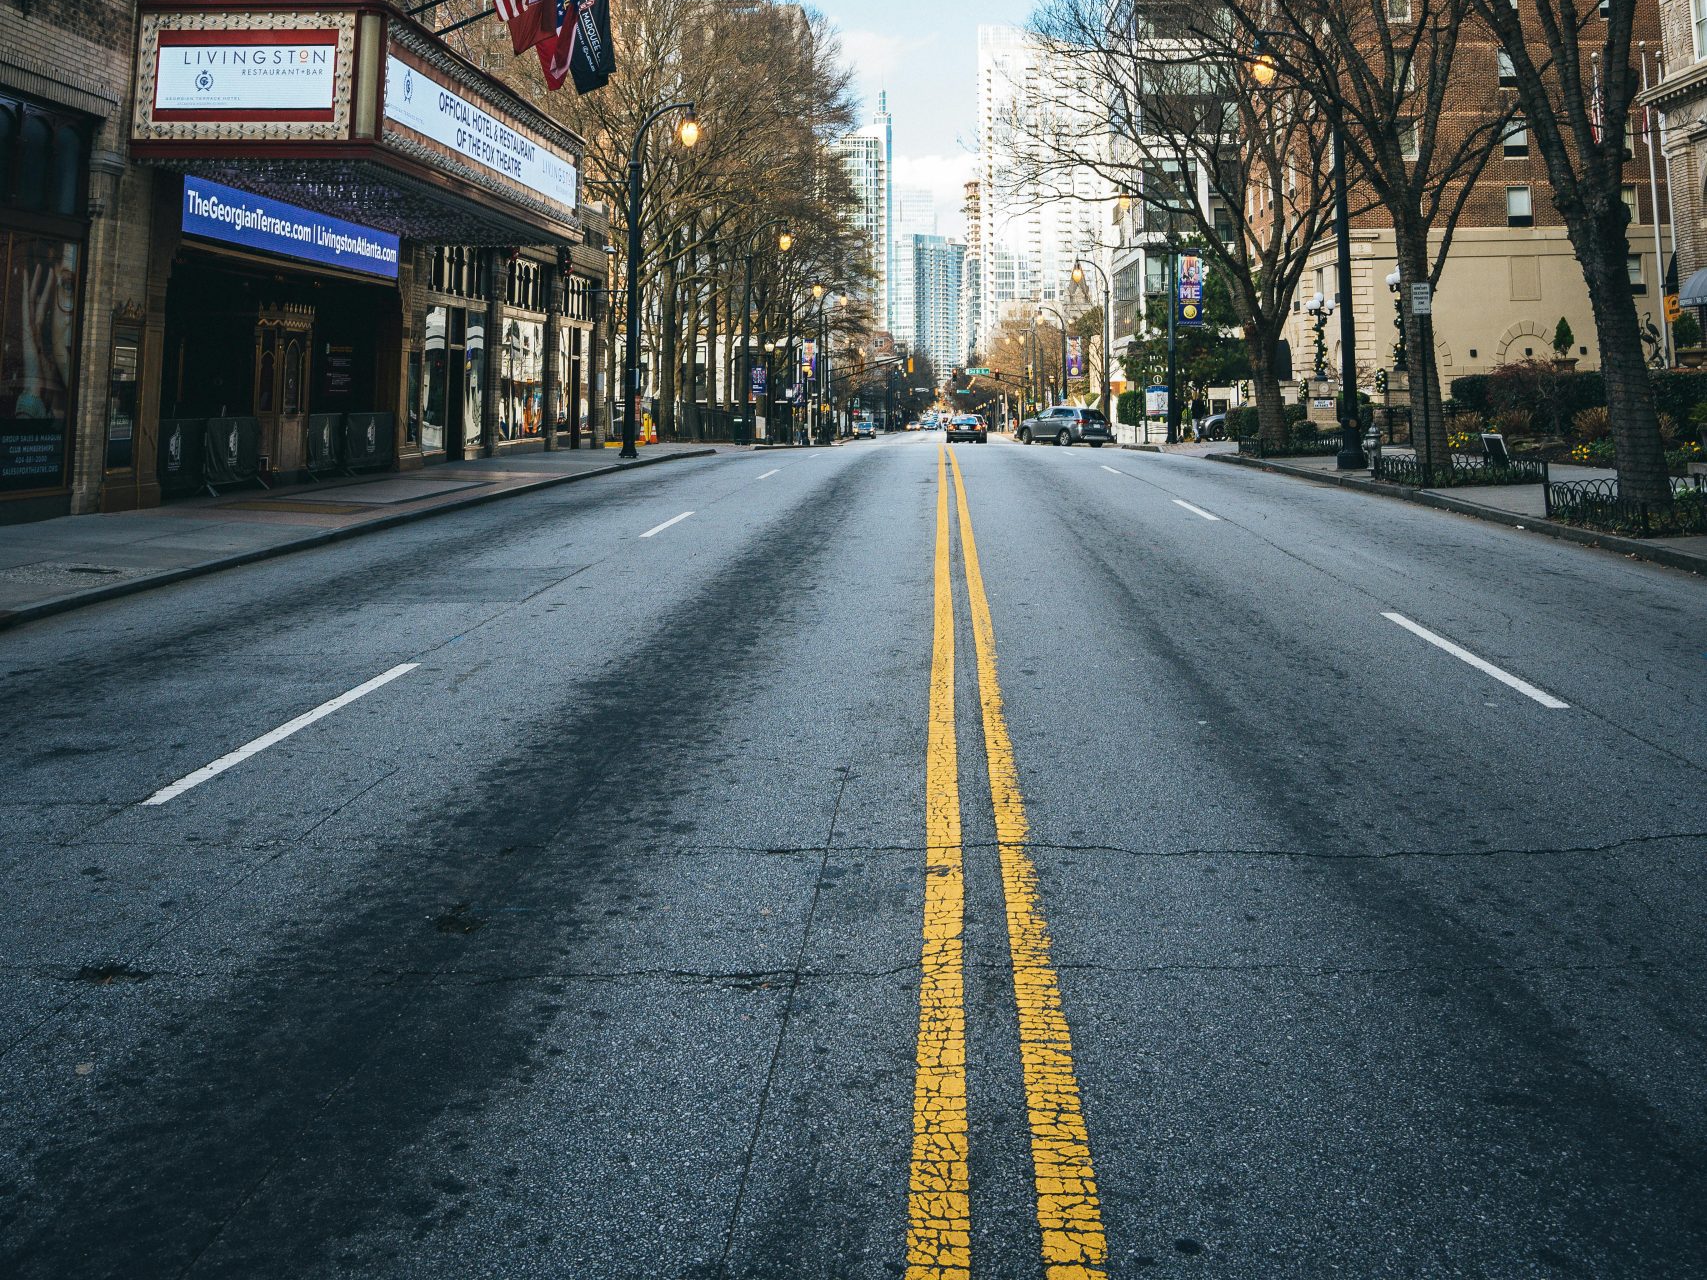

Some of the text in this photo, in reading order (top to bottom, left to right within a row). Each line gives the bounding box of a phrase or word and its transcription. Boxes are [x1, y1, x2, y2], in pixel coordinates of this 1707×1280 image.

[582, 11, 601, 52] MARQUEE
[184, 49, 326, 65] LIVINGSTON
[439, 92, 470, 127] OFFICIAL
[472, 111, 493, 140] HOTEL
[494, 124, 498, 142] &
[499, 127, 536, 163] RESTAURANT
[456, 128, 522, 178] OF THE FOX THEATRE
[187, 189, 311, 242] TheGeorgianTerrace.com
[317, 225, 397, 263] LivingstonAtlanta.com
[1180, 287, 1201, 299] ME
